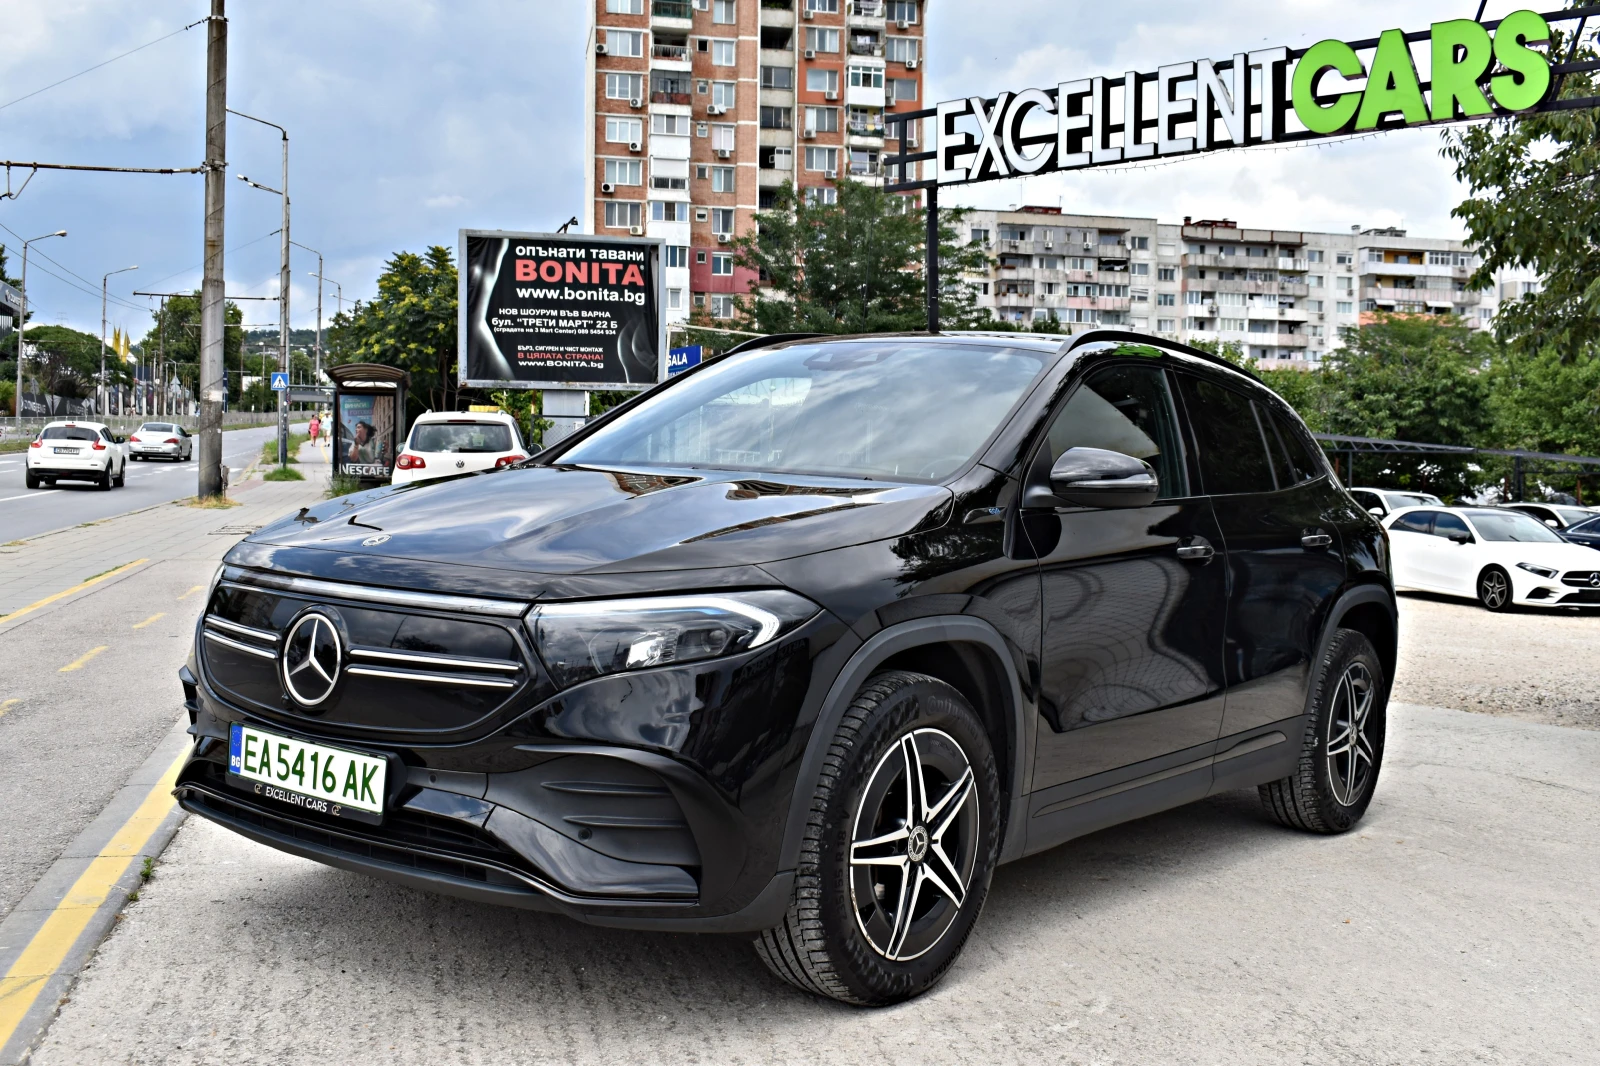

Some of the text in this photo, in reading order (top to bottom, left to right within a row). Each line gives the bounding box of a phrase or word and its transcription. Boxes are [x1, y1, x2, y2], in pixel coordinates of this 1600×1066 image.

[936, 10, 1551, 184] EXCELLENT CARS
[516, 245, 645, 261] опънати тавани
[515, 259, 645, 286] BONITA
[516, 287, 646, 306] www.bonita.bg
[520, 308, 558, 317] ШОУРУМ
[581, 310, 611, 318] ВАРНА
[491, 317, 514, 327] бул.
[595, 320, 608, 329] 22
[610, 321, 618, 329] Б
[526, 352, 563, 360] ЦЯЛАТА
[518, 360, 604, 369] www.BONITA.bg
[230, 754, 241, 768] BG
[265, 787, 305, 807] EXCELLENT
[305, 799, 328, 813] CARS
